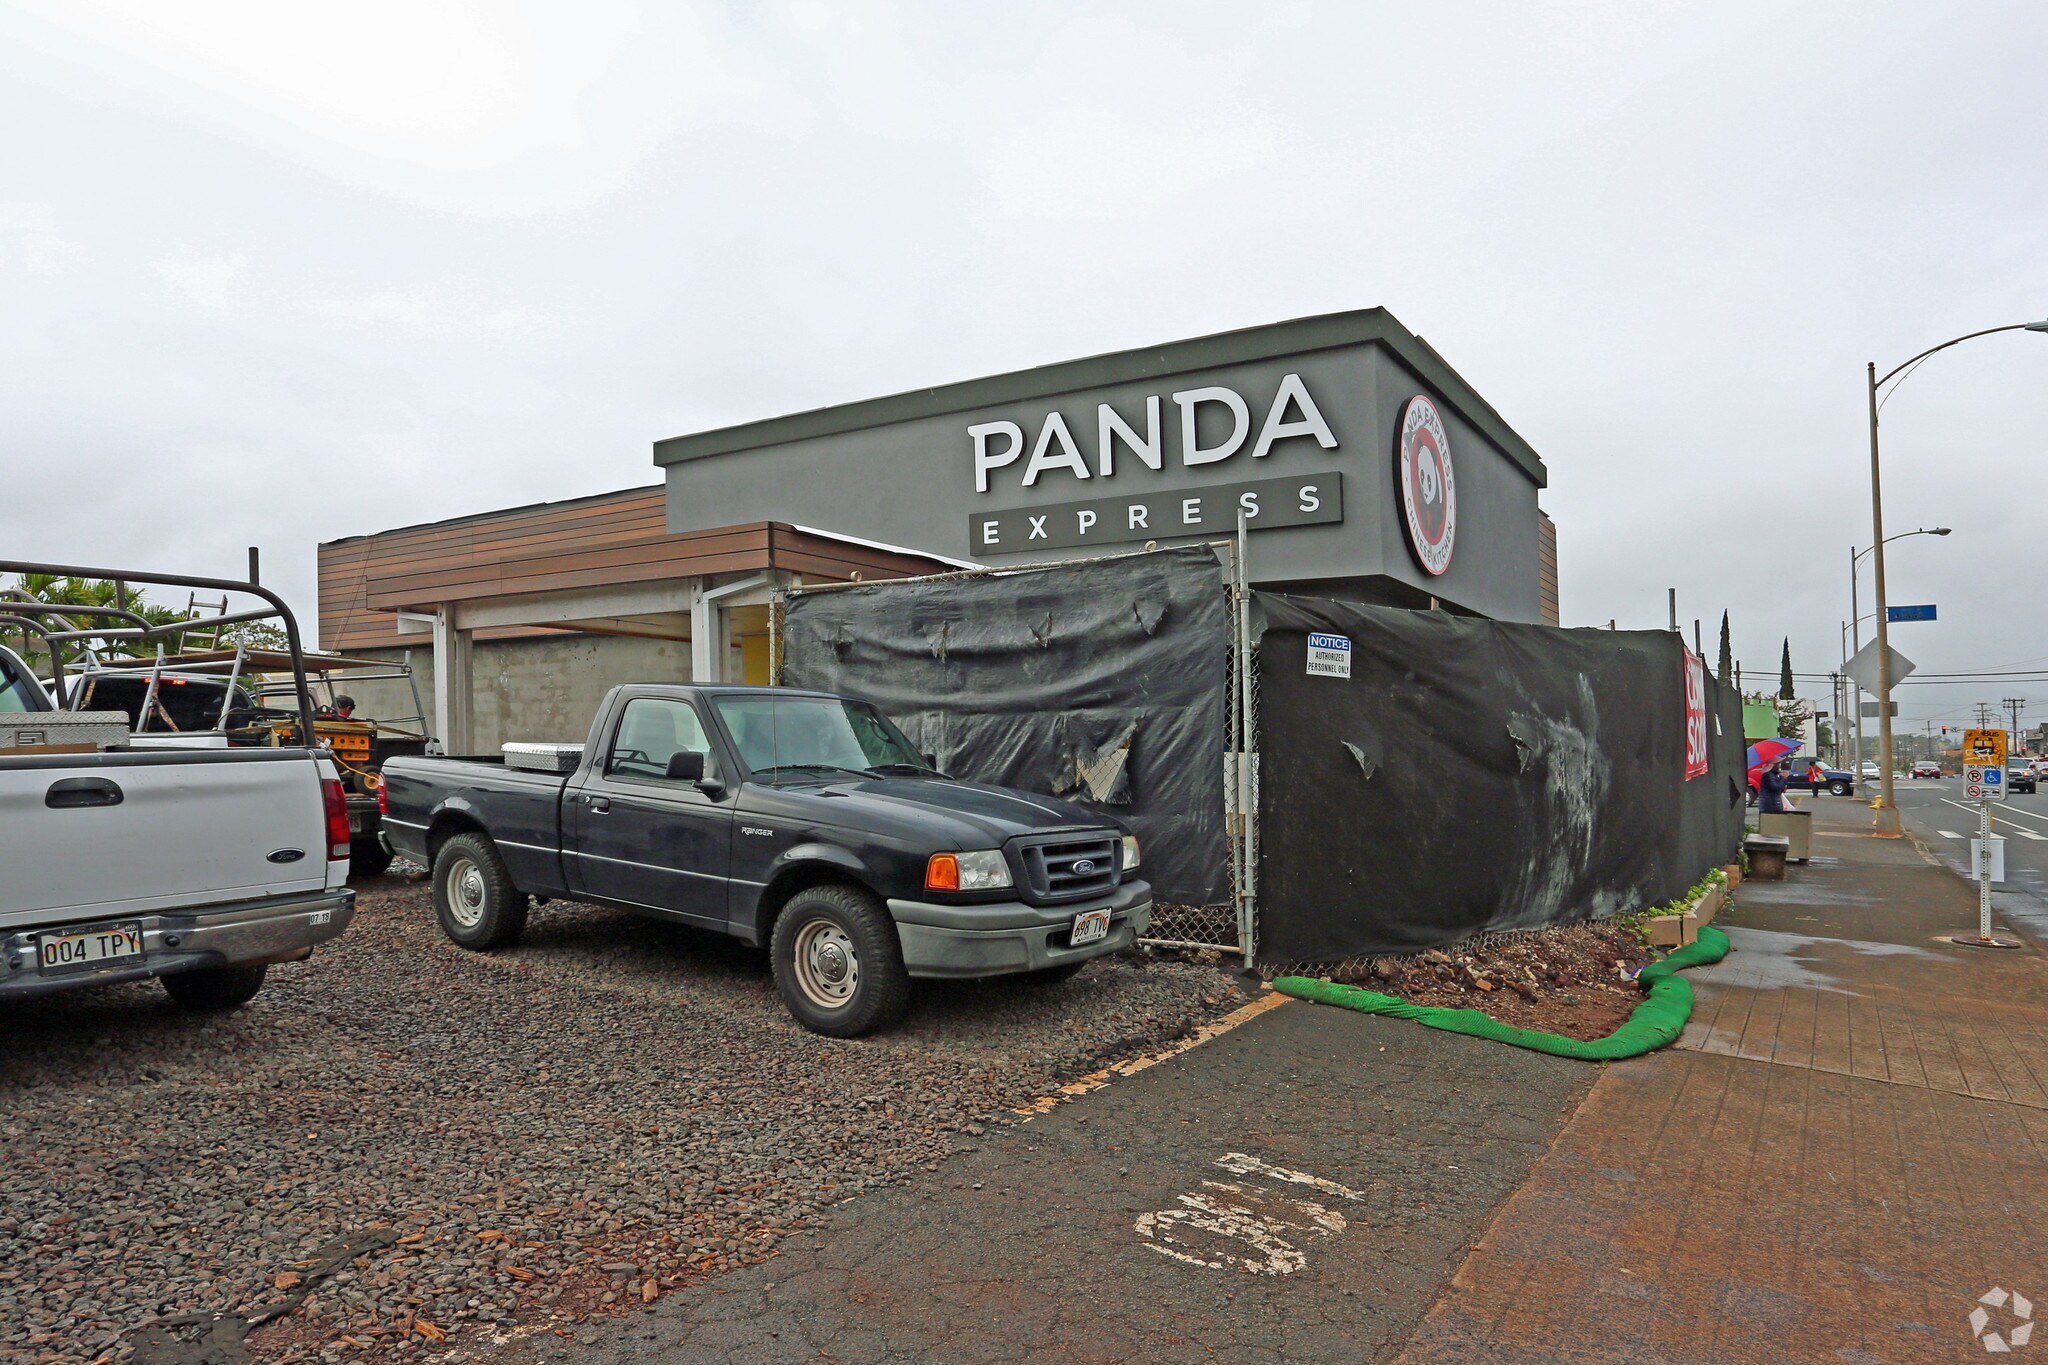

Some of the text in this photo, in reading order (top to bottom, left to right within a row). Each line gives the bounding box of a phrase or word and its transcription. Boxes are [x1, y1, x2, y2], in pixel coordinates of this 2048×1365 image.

[967, 373, 1339, 493] PANDA
[1403, 405, 1422, 462] PNDA
[983, 485, 1321, 545] EXPRESS
[1407, 497, 1453, 565] CHINESE KITCHEN
[1310, 635, 1349, 650] NOTICE
[1315, 651, 1344, 662] AUTHORIZED
[1307, 661, 1337, 674] PERSONNEL
[741, 826, 773, 837] RANGER
[44, 931, 137, 965] 004 TPY
